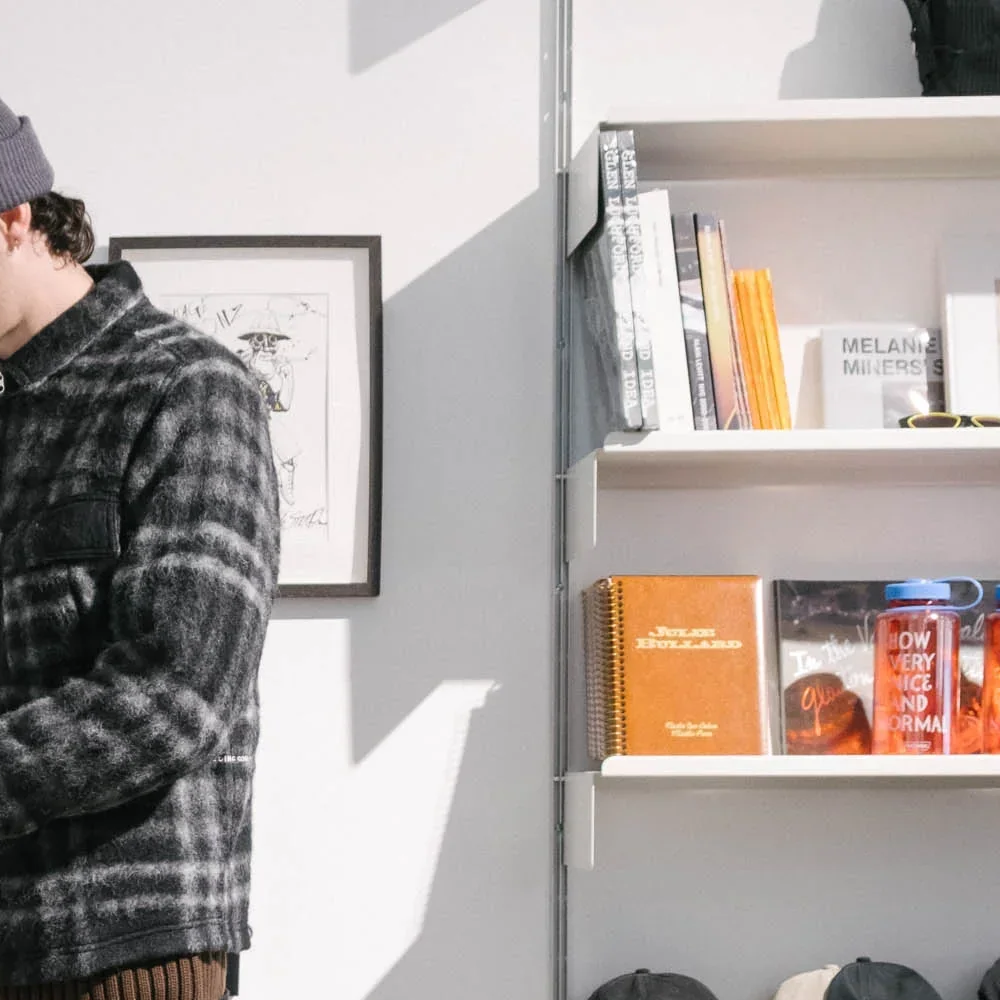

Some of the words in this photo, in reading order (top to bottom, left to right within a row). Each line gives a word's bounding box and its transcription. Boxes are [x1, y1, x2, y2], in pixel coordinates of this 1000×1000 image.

[842, 337, 937, 354] MELANIE
[888, 631, 931, 650] HOW
[887, 653, 936, 672] VERY
[887, 714, 949, 734] ORMAL
